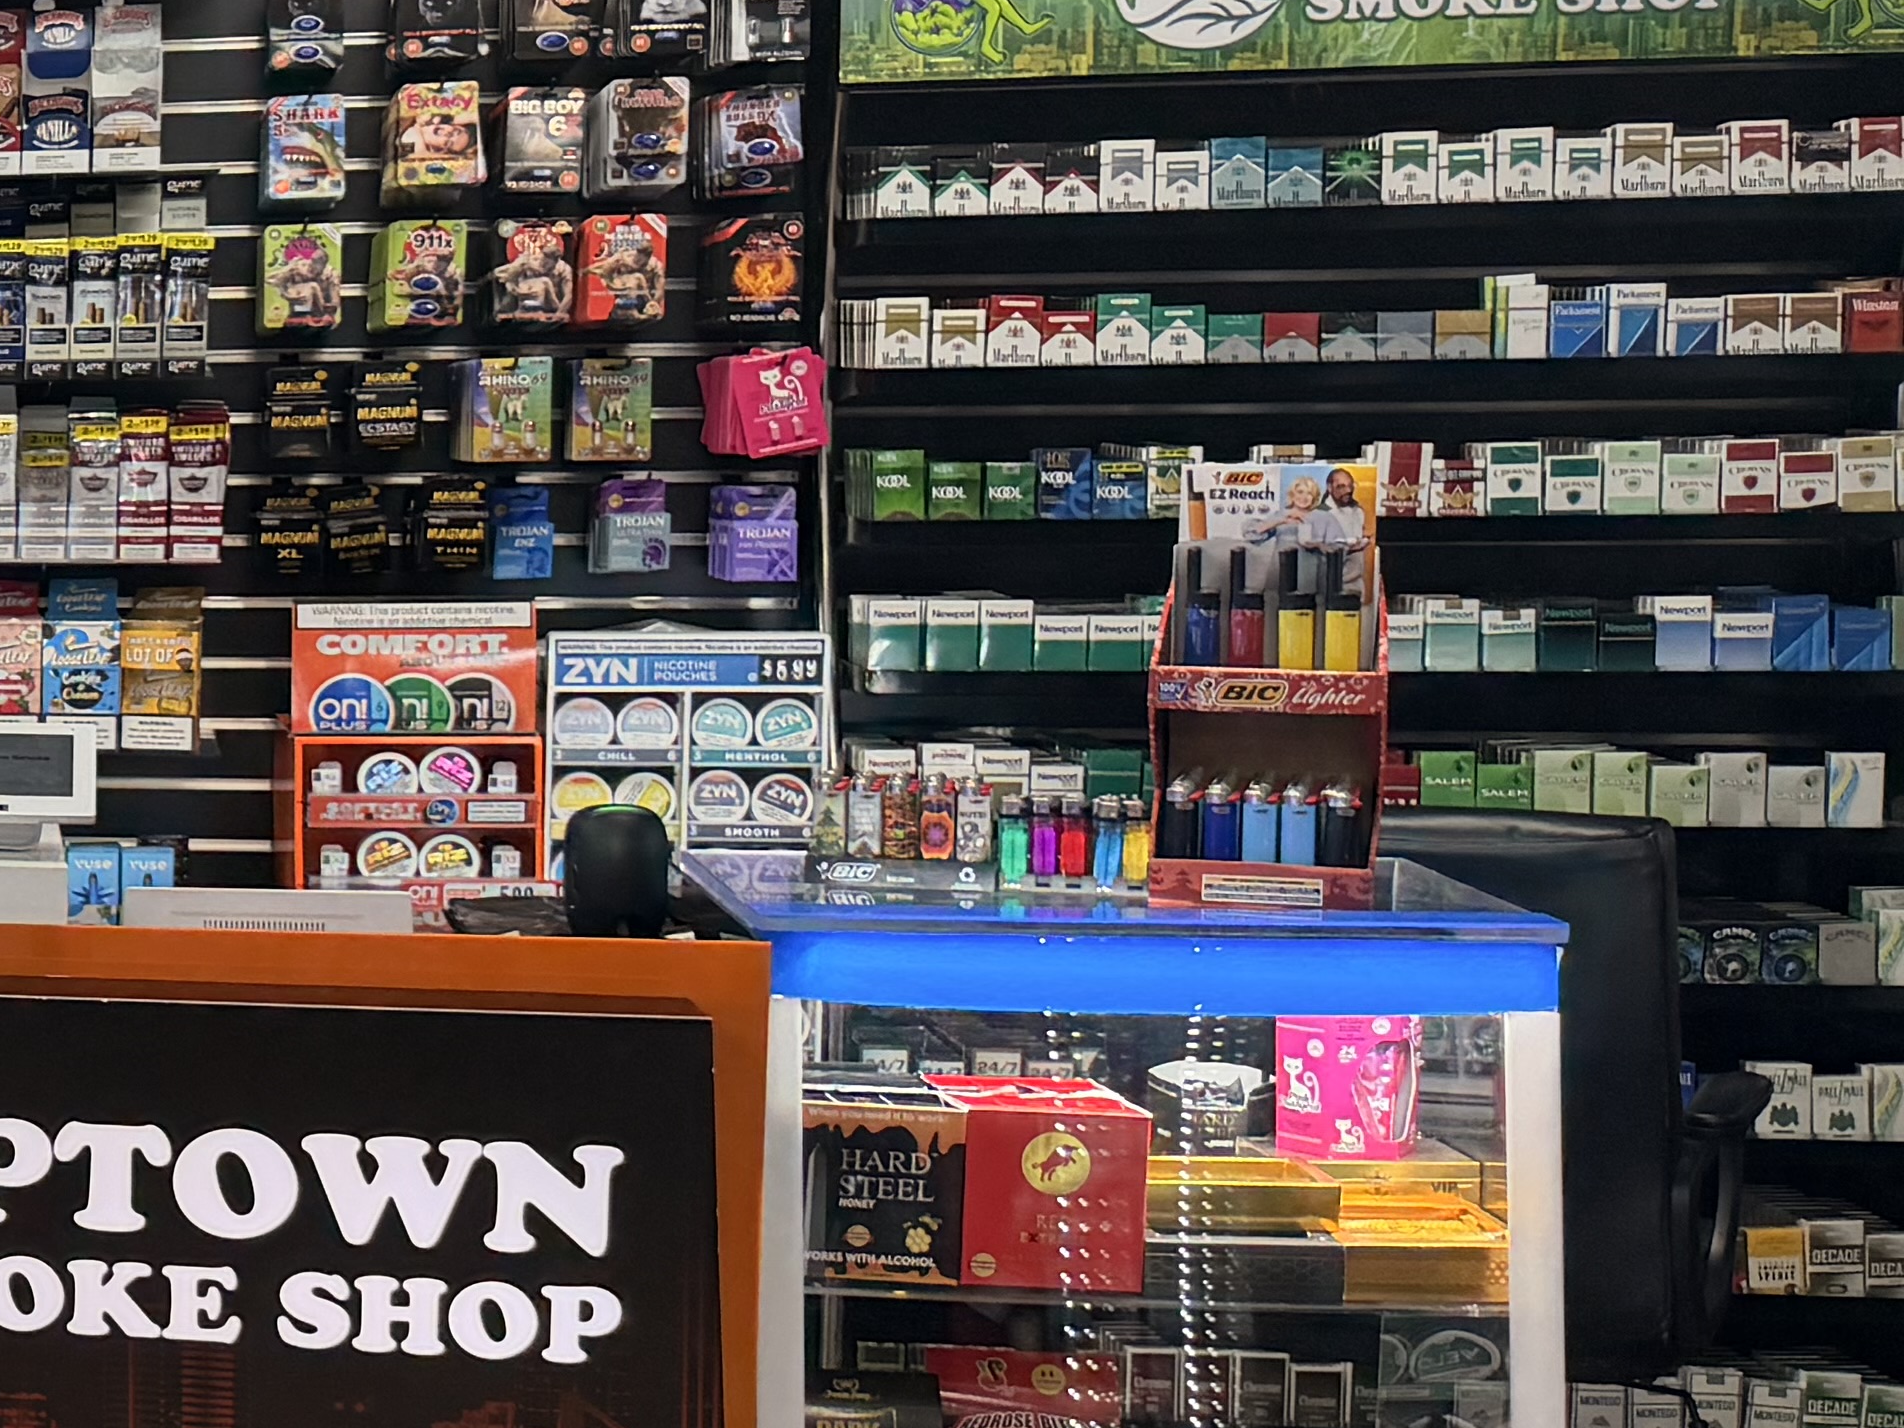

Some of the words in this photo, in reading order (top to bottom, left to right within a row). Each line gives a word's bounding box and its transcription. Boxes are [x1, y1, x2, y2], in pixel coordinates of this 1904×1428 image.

[510, 100, 542, 114] BIG
[544, 100, 583, 114] BOY
[1621, 174, 1666, 193] Marlboro
[1738, 171, 1785, 189] Marlboro
[1851, 297, 1899, 312] Winston
[478, 372, 531, 387] RHINO
[579, 372, 630, 387] RHINO
[357, 404, 418, 422] MAGNUM
[271, 413, 327, 430] MAGNUM
[358, 421, 418, 436] ECSTASY
[876, 475, 911, 489] KOOL
[1225, 470, 1262, 485] BIC
[932, 484, 967, 501] KOOL
[988, 484, 1023, 501] KOOL
[1209, 487, 1226, 501] EZ
[1229, 487, 1275, 501] Reach
[615, 514, 665, 529] TROJAN
[260, 531, 319, 546] MAGNUM
[501, 525, 549, 538] TROJAN
[737, 526, 791, 541] TROJAN
[277, 547, 303, 559] XL
[369, 606, 388, 615] This
[391, 606, 428, 618] product
[432, 606, 472, 615] contains
[873, 608, 917, 619] Newport
[1660, 604, 1707, 616] Newport
[1722, 622, 1769, 634] Newport
[316, 634, 509, 656] COMFORT.
[563, 658, 638, 684] ZYN
[654, 661, 717, 671] NICOTINE
[654, 673, 717, 682] POUCHES
[1222, 682, 1284, 704] BIC
[1292, 682, 1365, 707] Lighter
[318, 698, 368, 720] on!
[598, 752, 635, 760] CHILL
[725, 752, 788, 761] MENTHOL
[1424, 776, 1472, 787] SALEM
[1481, 787, 1530, 798] SALEM
[724, 826, 780, 838] SMOOTH
[74, 858, 115, 871] vuse
[831, 864, 878, 879] BIC
[1712, 929, 1758, 941] CAMEL
[840, 1149, 932, 1173] HARD
[838, 1176, 935, 1202] STEEL
[838, 1196, 876, 1210] HONEY
[1812, 1248, 1862, 1265] DECADE
[277, 1271, 622, 1365] SHOP
[1580, 1395, 1622, 1408] MONTEGO
[1808, 1401, 1858, 1416] DECADE
